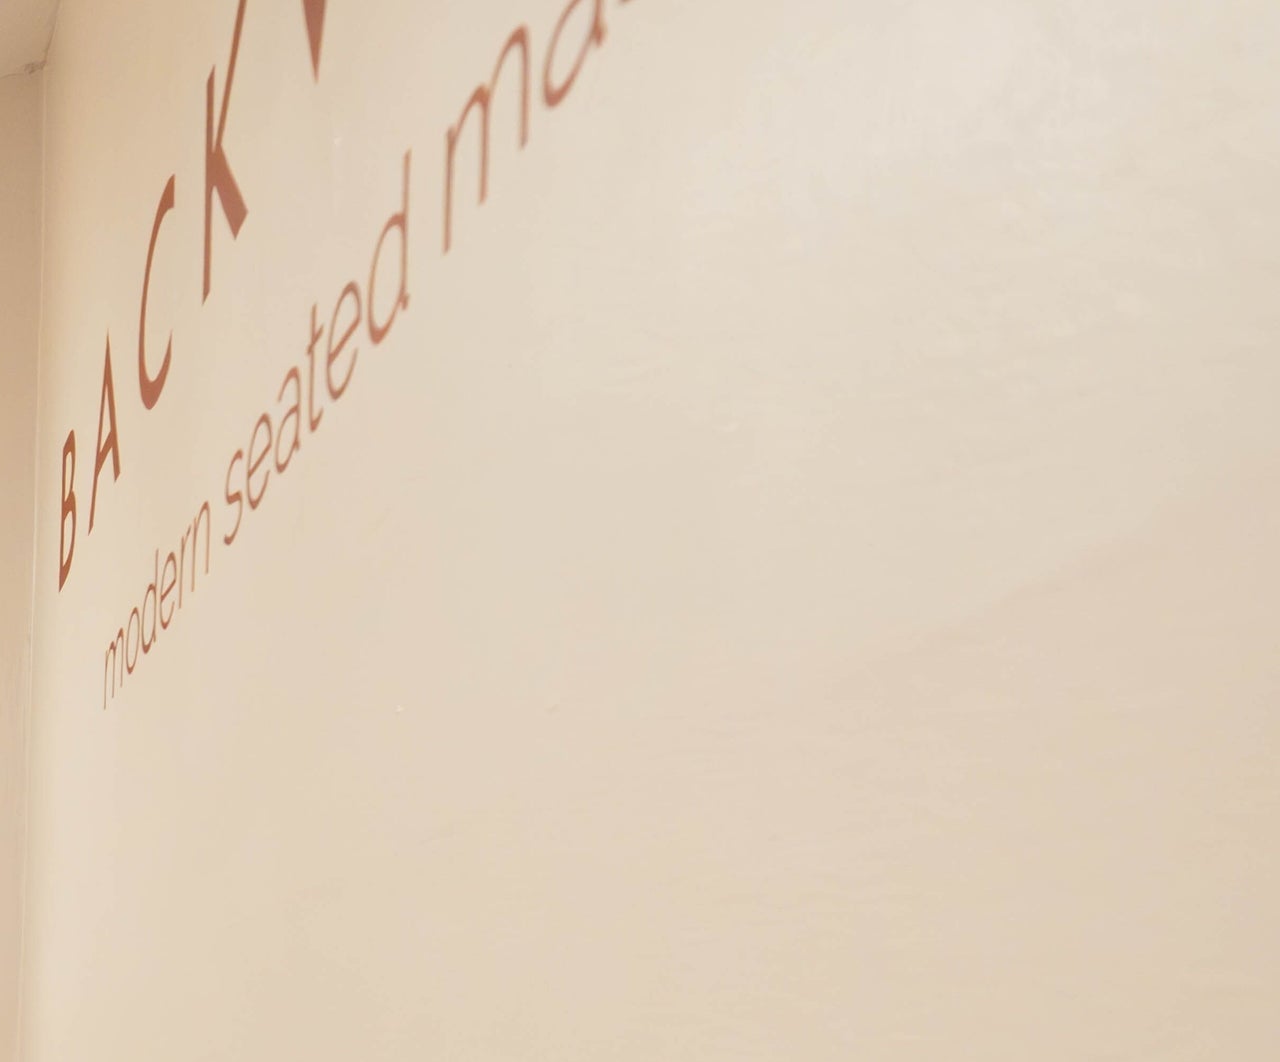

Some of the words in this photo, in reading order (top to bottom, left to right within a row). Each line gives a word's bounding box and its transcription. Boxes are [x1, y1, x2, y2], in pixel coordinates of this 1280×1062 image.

[59, 0, 248, 592] BACK
[103, 501, 211, 710] modern
[224, 148, 412, 545] seated
[443, 0, 635, 254] ma
